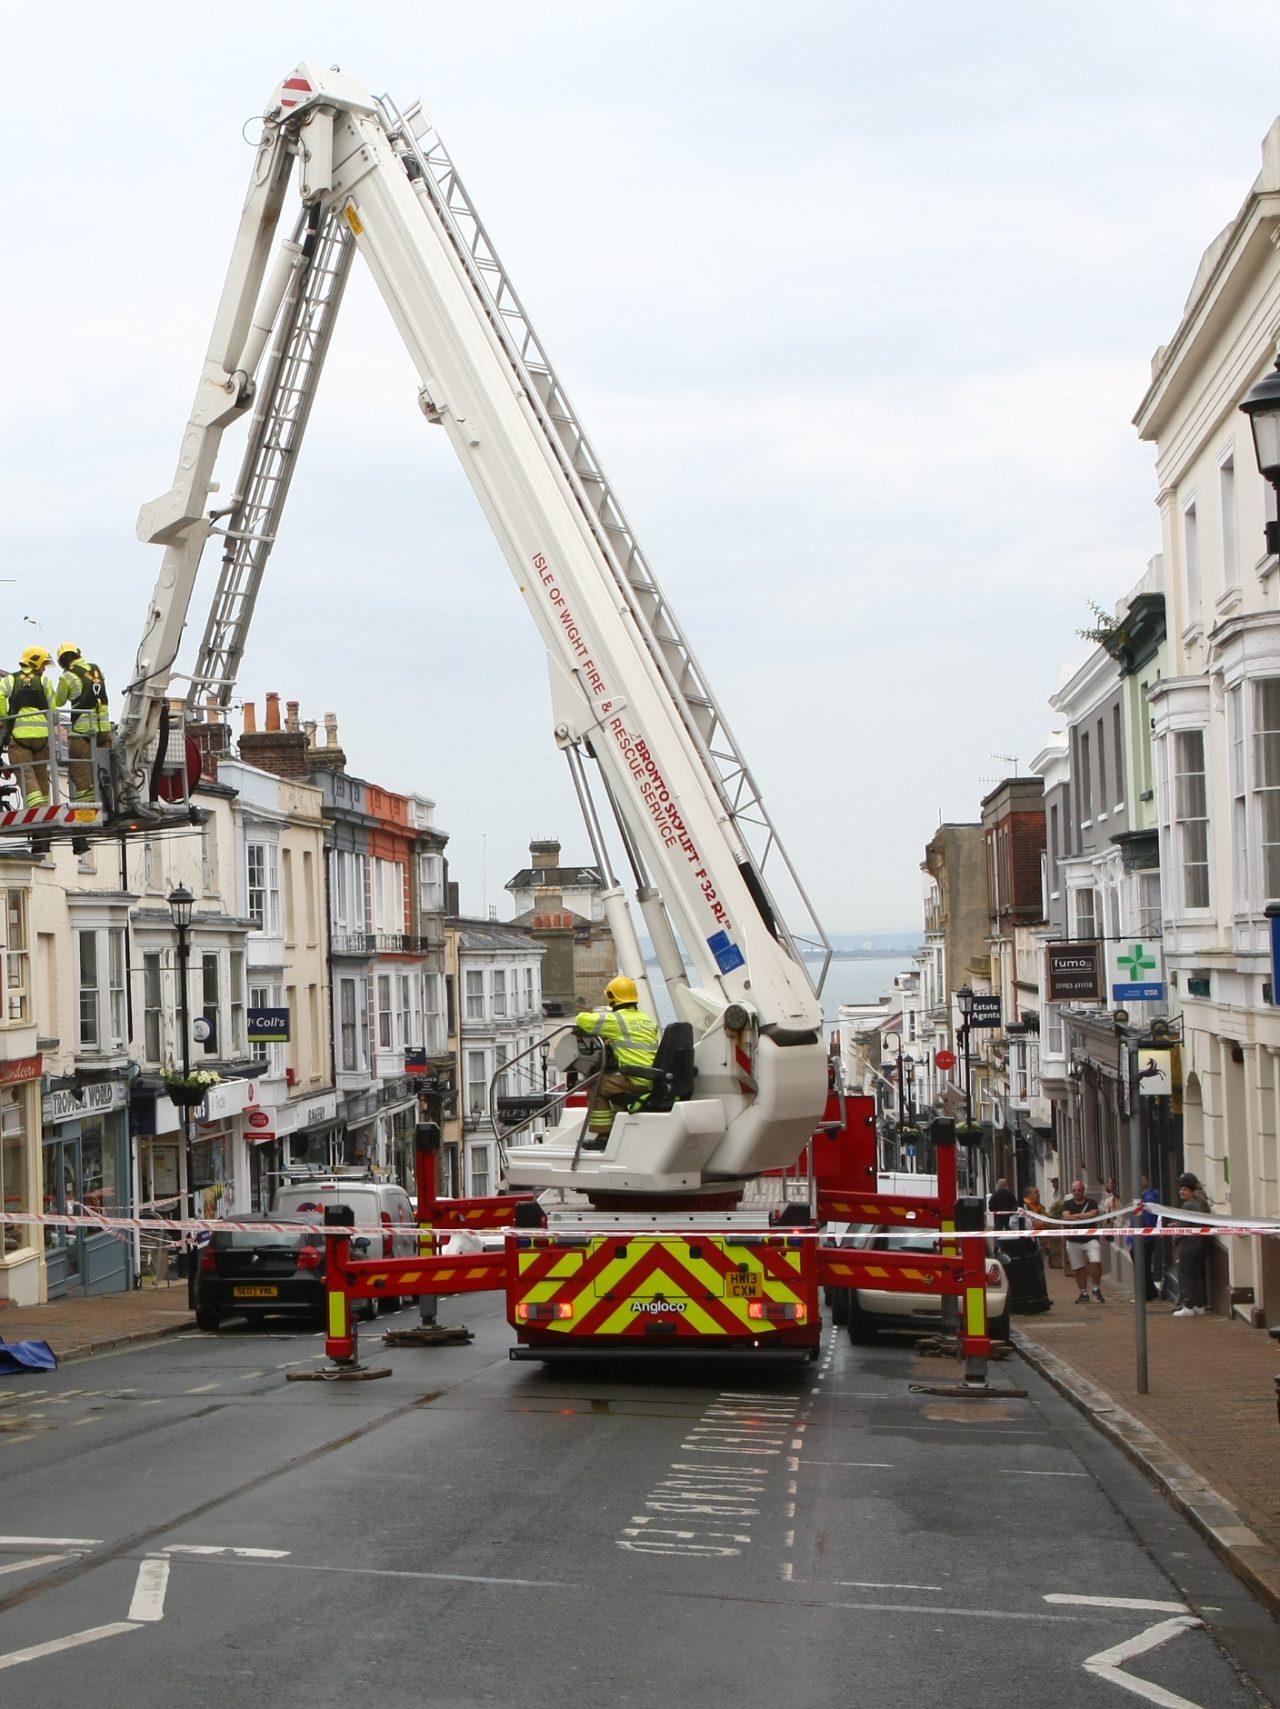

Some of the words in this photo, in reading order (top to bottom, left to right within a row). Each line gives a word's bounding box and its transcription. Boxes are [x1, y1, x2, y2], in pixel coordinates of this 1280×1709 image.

[532, 552, 554, 586] ISLE
[549, 588, 565, 608] OF
[559, 609, 589, 657] WIGHT
[583, 660, 606, 695] FIRE
[601, 701, 612, 713] &
[610, 717, 646, 781] RESCUE
[640, 782, 678, 849] SERVICE
[634, 739, 670, 803] BRONTO
[695, 868, 708, 879] F
[1055, 959, 1086, 968] fumo
[972, 1012, 1000, 1021] Agents
[53, 1088, 87, 1115] TROPIL
[88, 1084, 112, 1107] WORLD
[731, 1274, 757, 1284] HW13
[733, 1286, 757, 1296] CXM
[631, 1300, 686, 1315] Angloco
[615, 1463, 769, 1557] DISABLED
